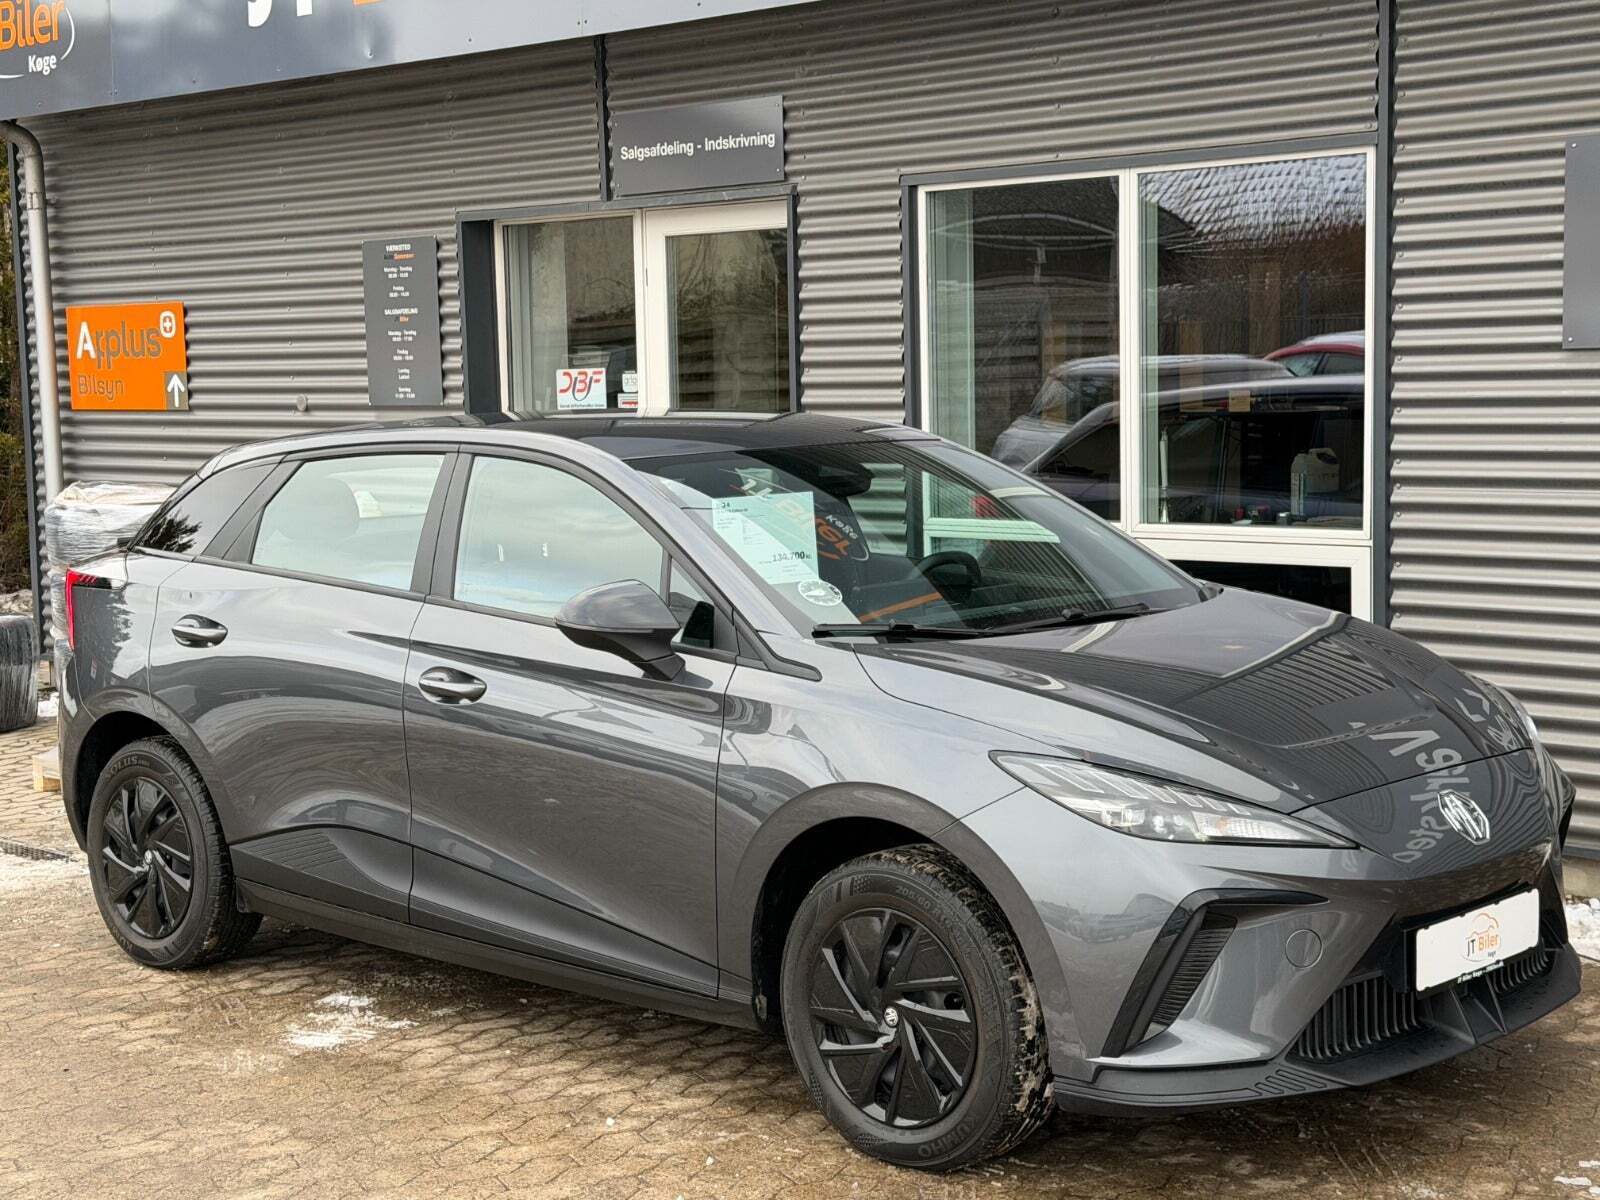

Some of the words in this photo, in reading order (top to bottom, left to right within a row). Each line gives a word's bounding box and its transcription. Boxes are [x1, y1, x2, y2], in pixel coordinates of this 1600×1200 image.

[0, 0, 64, 51] Biler
[28, 54, 57, 75] Køge
[620, 141, 694, 161] Salgsafdeling
[704, 132, 775, 151] Indskrivning
[79, 374, 124, 401] Bilsyn
